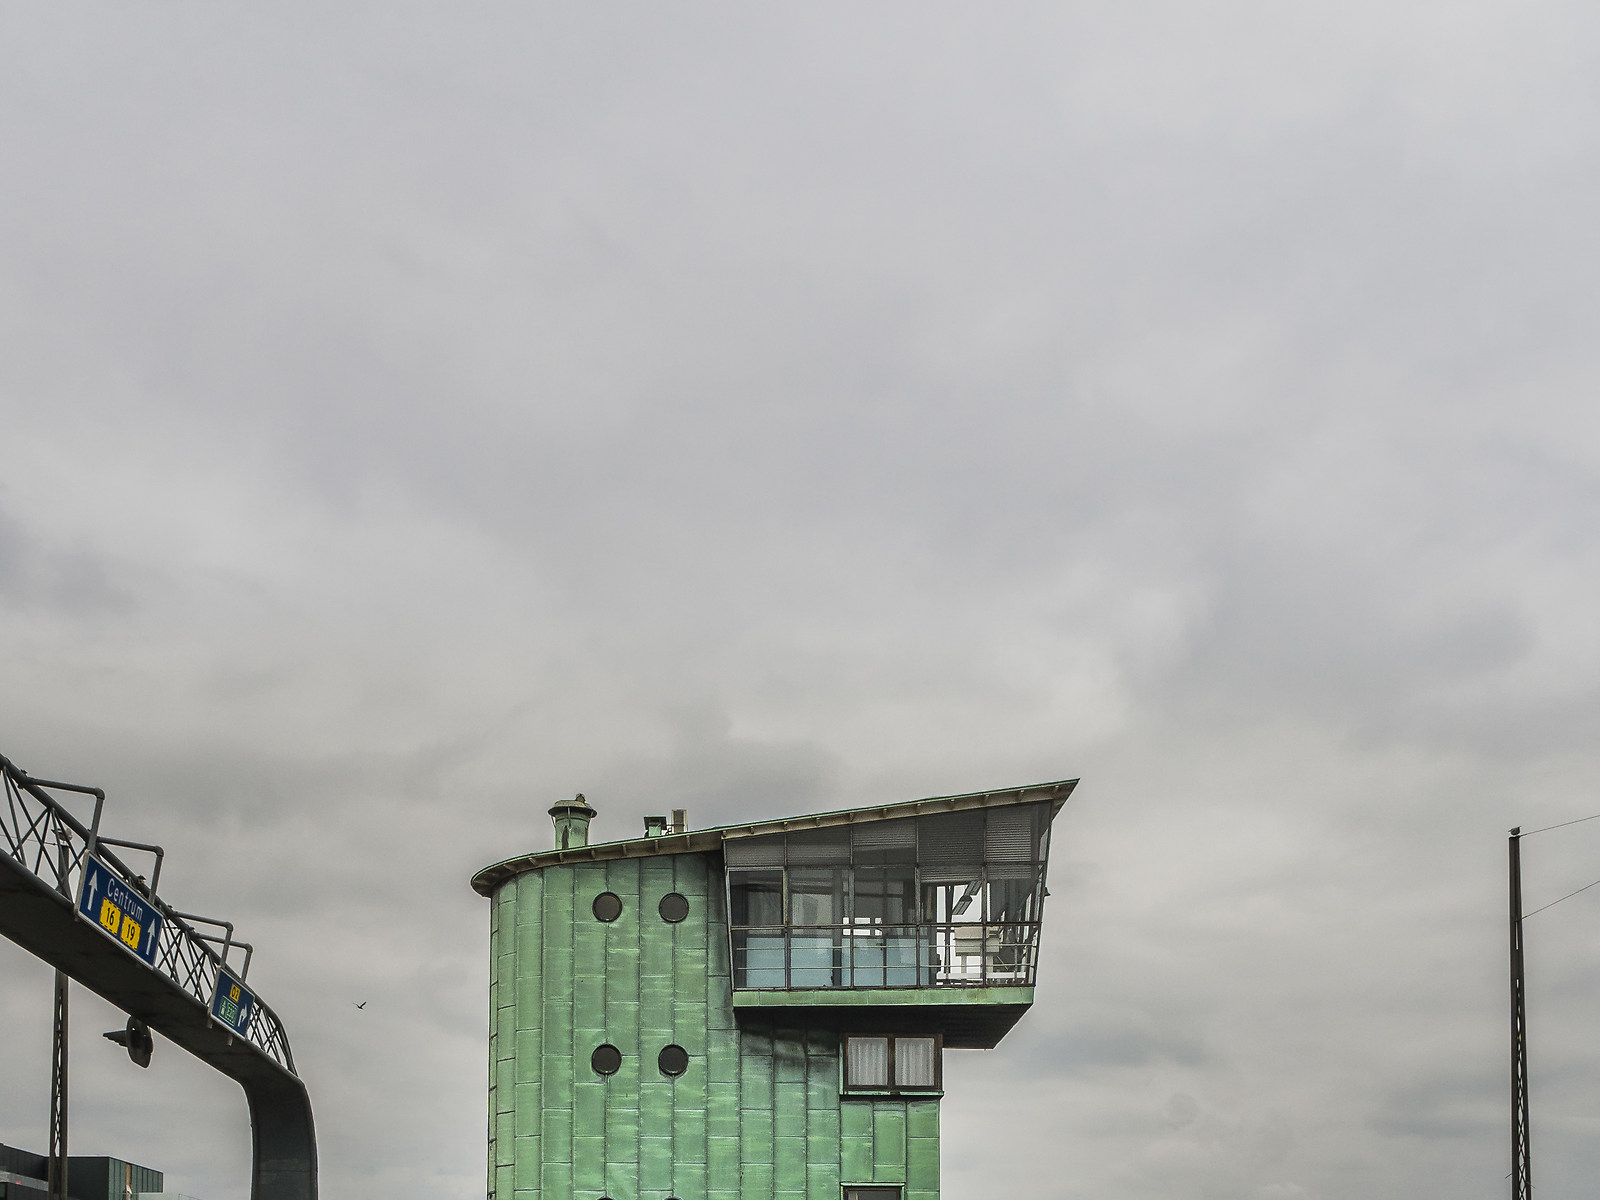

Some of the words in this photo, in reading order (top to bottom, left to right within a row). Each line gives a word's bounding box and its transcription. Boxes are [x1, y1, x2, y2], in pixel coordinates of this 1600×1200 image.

[107, 878, 143, 921] Centrum
[106, 907, 115, 926] 16
[126, 923, 136, 941] 19
